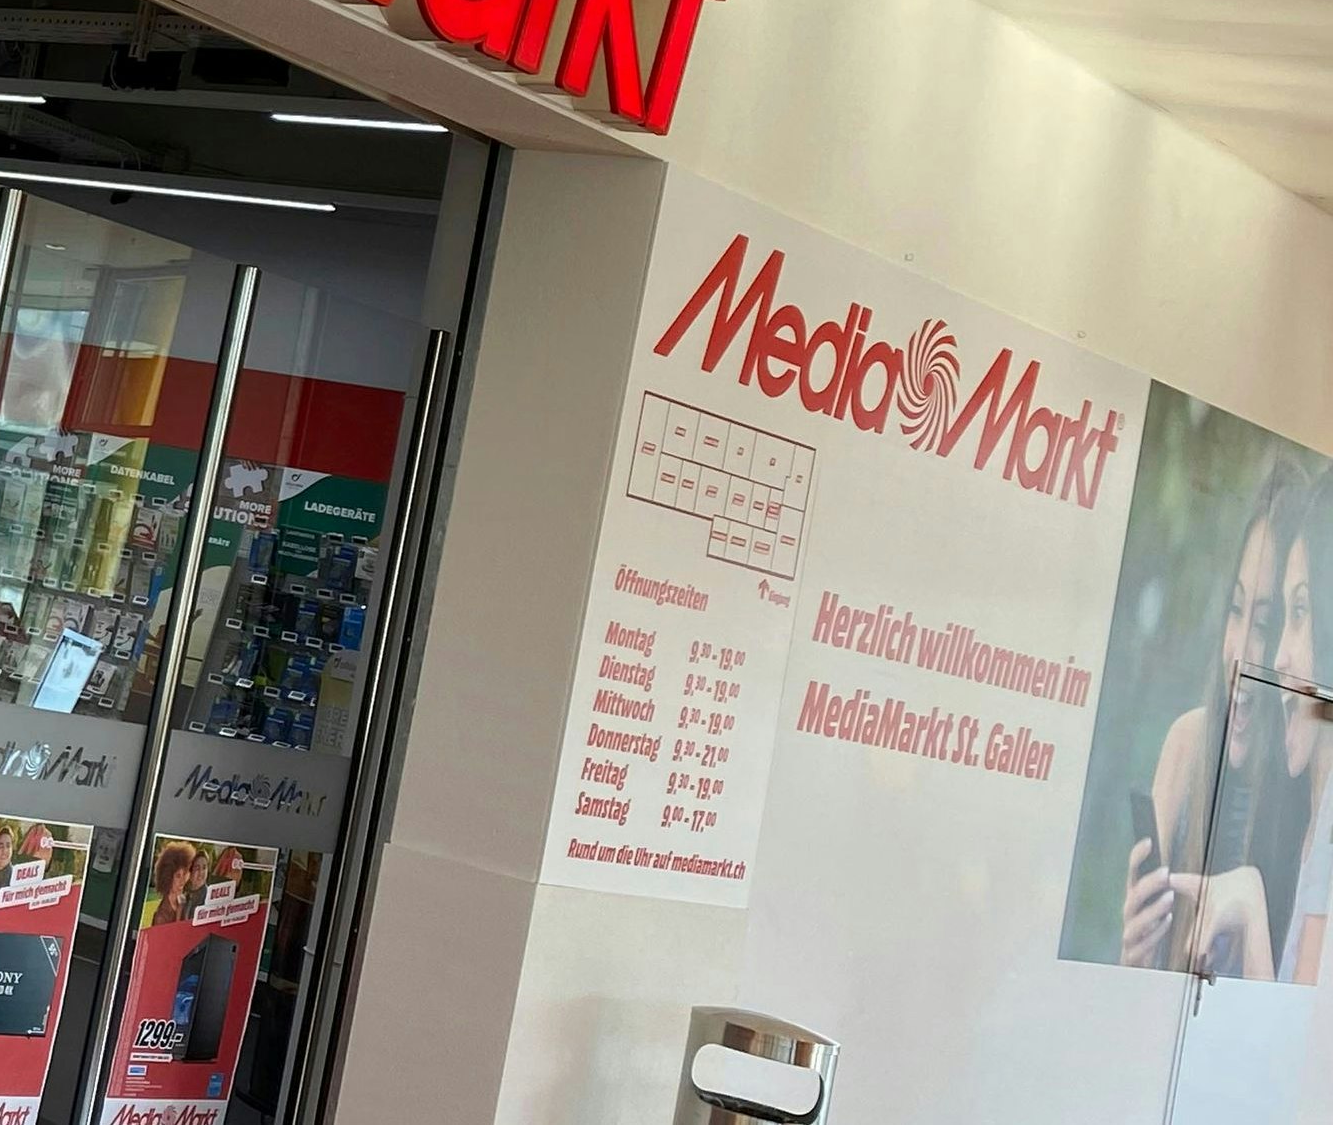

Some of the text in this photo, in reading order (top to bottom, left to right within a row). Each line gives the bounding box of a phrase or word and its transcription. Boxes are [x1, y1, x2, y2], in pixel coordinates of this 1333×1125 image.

[654, 233, 1120, 510] Media Markt
[52, 464, 81, 476] MORE
[110, 465, 175, 485] DATENKABEL
[239, 500, 271, 513] MORE
[304, 500, 376, 523] LADEGERÄTE
[615, 564, 709, 612] Öffnungszeiten
[605, 621, 656, 658] Montag
[812, 590, 1092, 707] Herzlich willkommen im
[598, 655, 656, 692] Dienstag
[593, 689, 655, 723] Mittwoch
[587, 723, 662, 763] Donnerstag
[796, 681, 1055, 782] MediaMarkt St. Gallen
[581, 757, 629, 791] Freitag
[575, 791, 631, 826] Samstag
[16, 865, 40, 880] DEALS
[567, 838, 746, 880] Rund um die Uhr auf mediamarkt.ch
